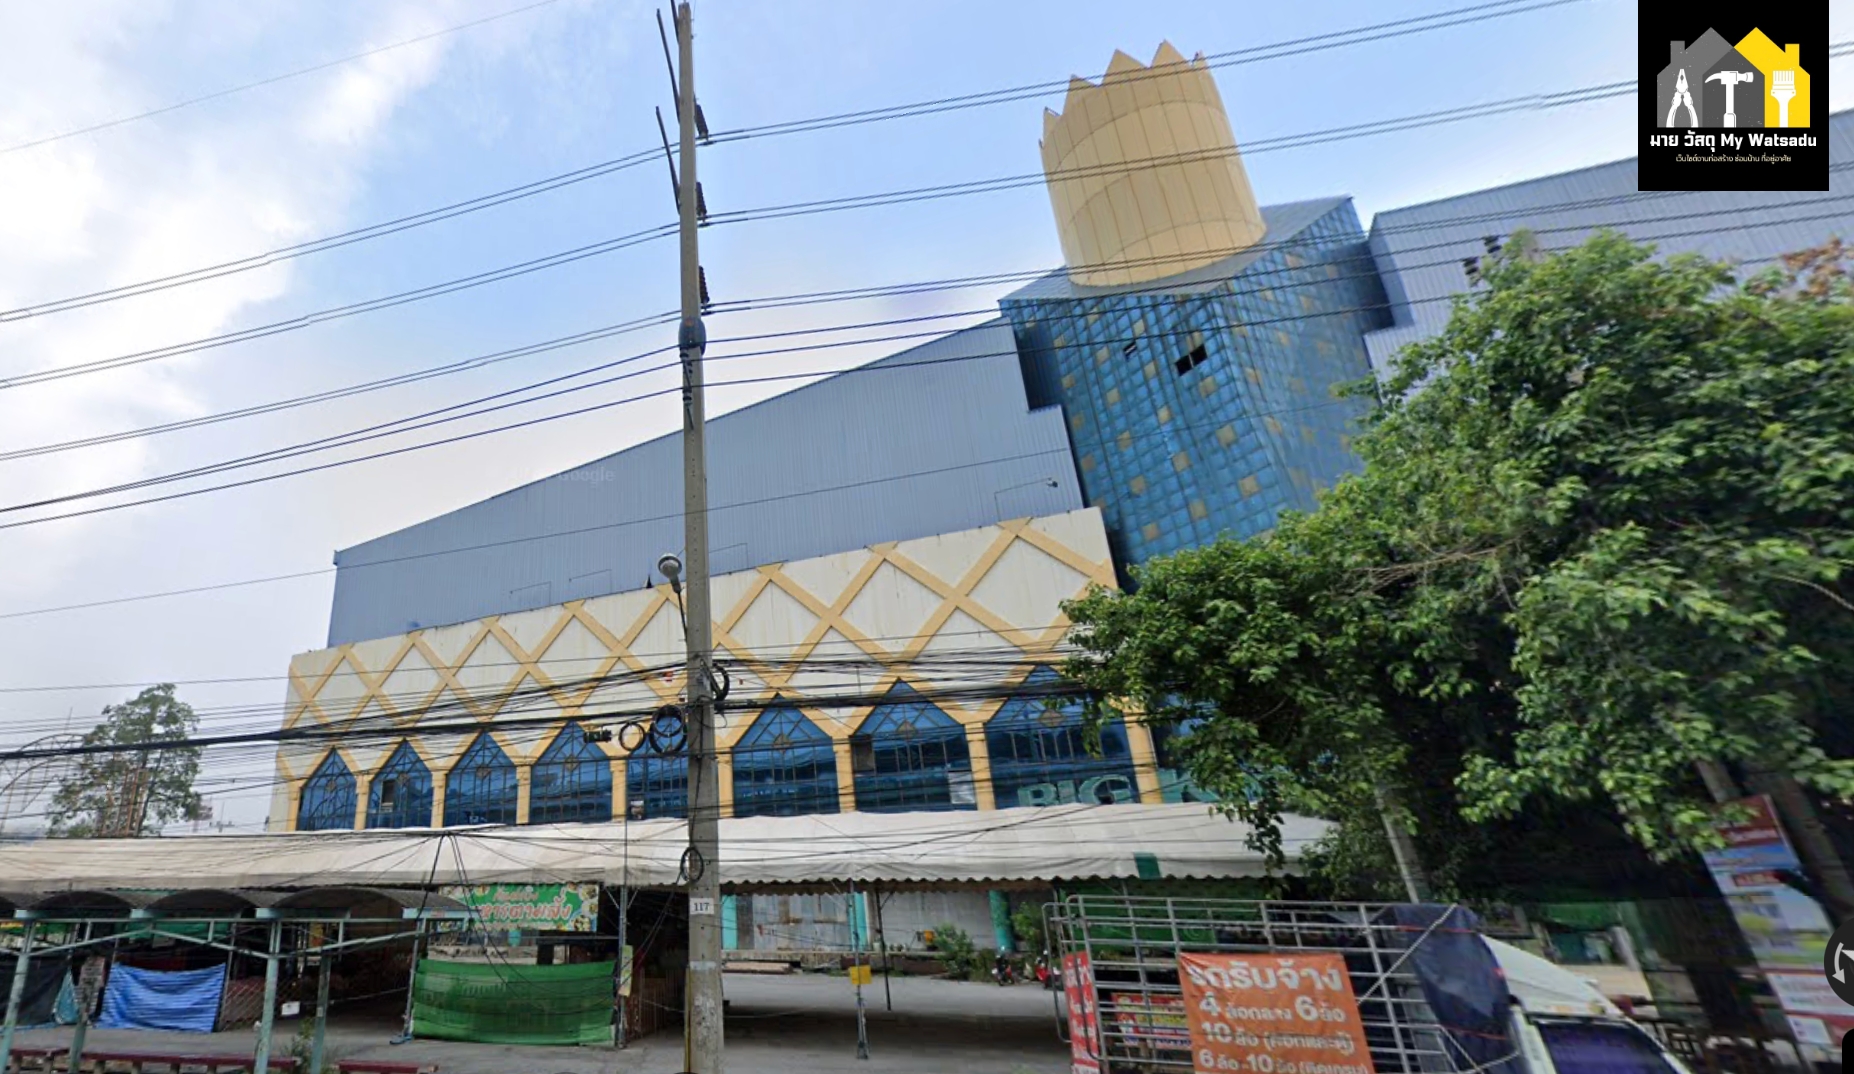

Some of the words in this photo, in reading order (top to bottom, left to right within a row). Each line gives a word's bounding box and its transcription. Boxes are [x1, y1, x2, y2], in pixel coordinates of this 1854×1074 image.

[1017, 775, 1130, 807] BIG
[694, 902, 710, 911] 117
[1187, 959, 1343, 990] รถรับจ้าง
[1199, 991, 1221, 1016] 4
[1201, 1021, 1232, 1044] 10
[1199, 1048, 1215, 1068] 6
